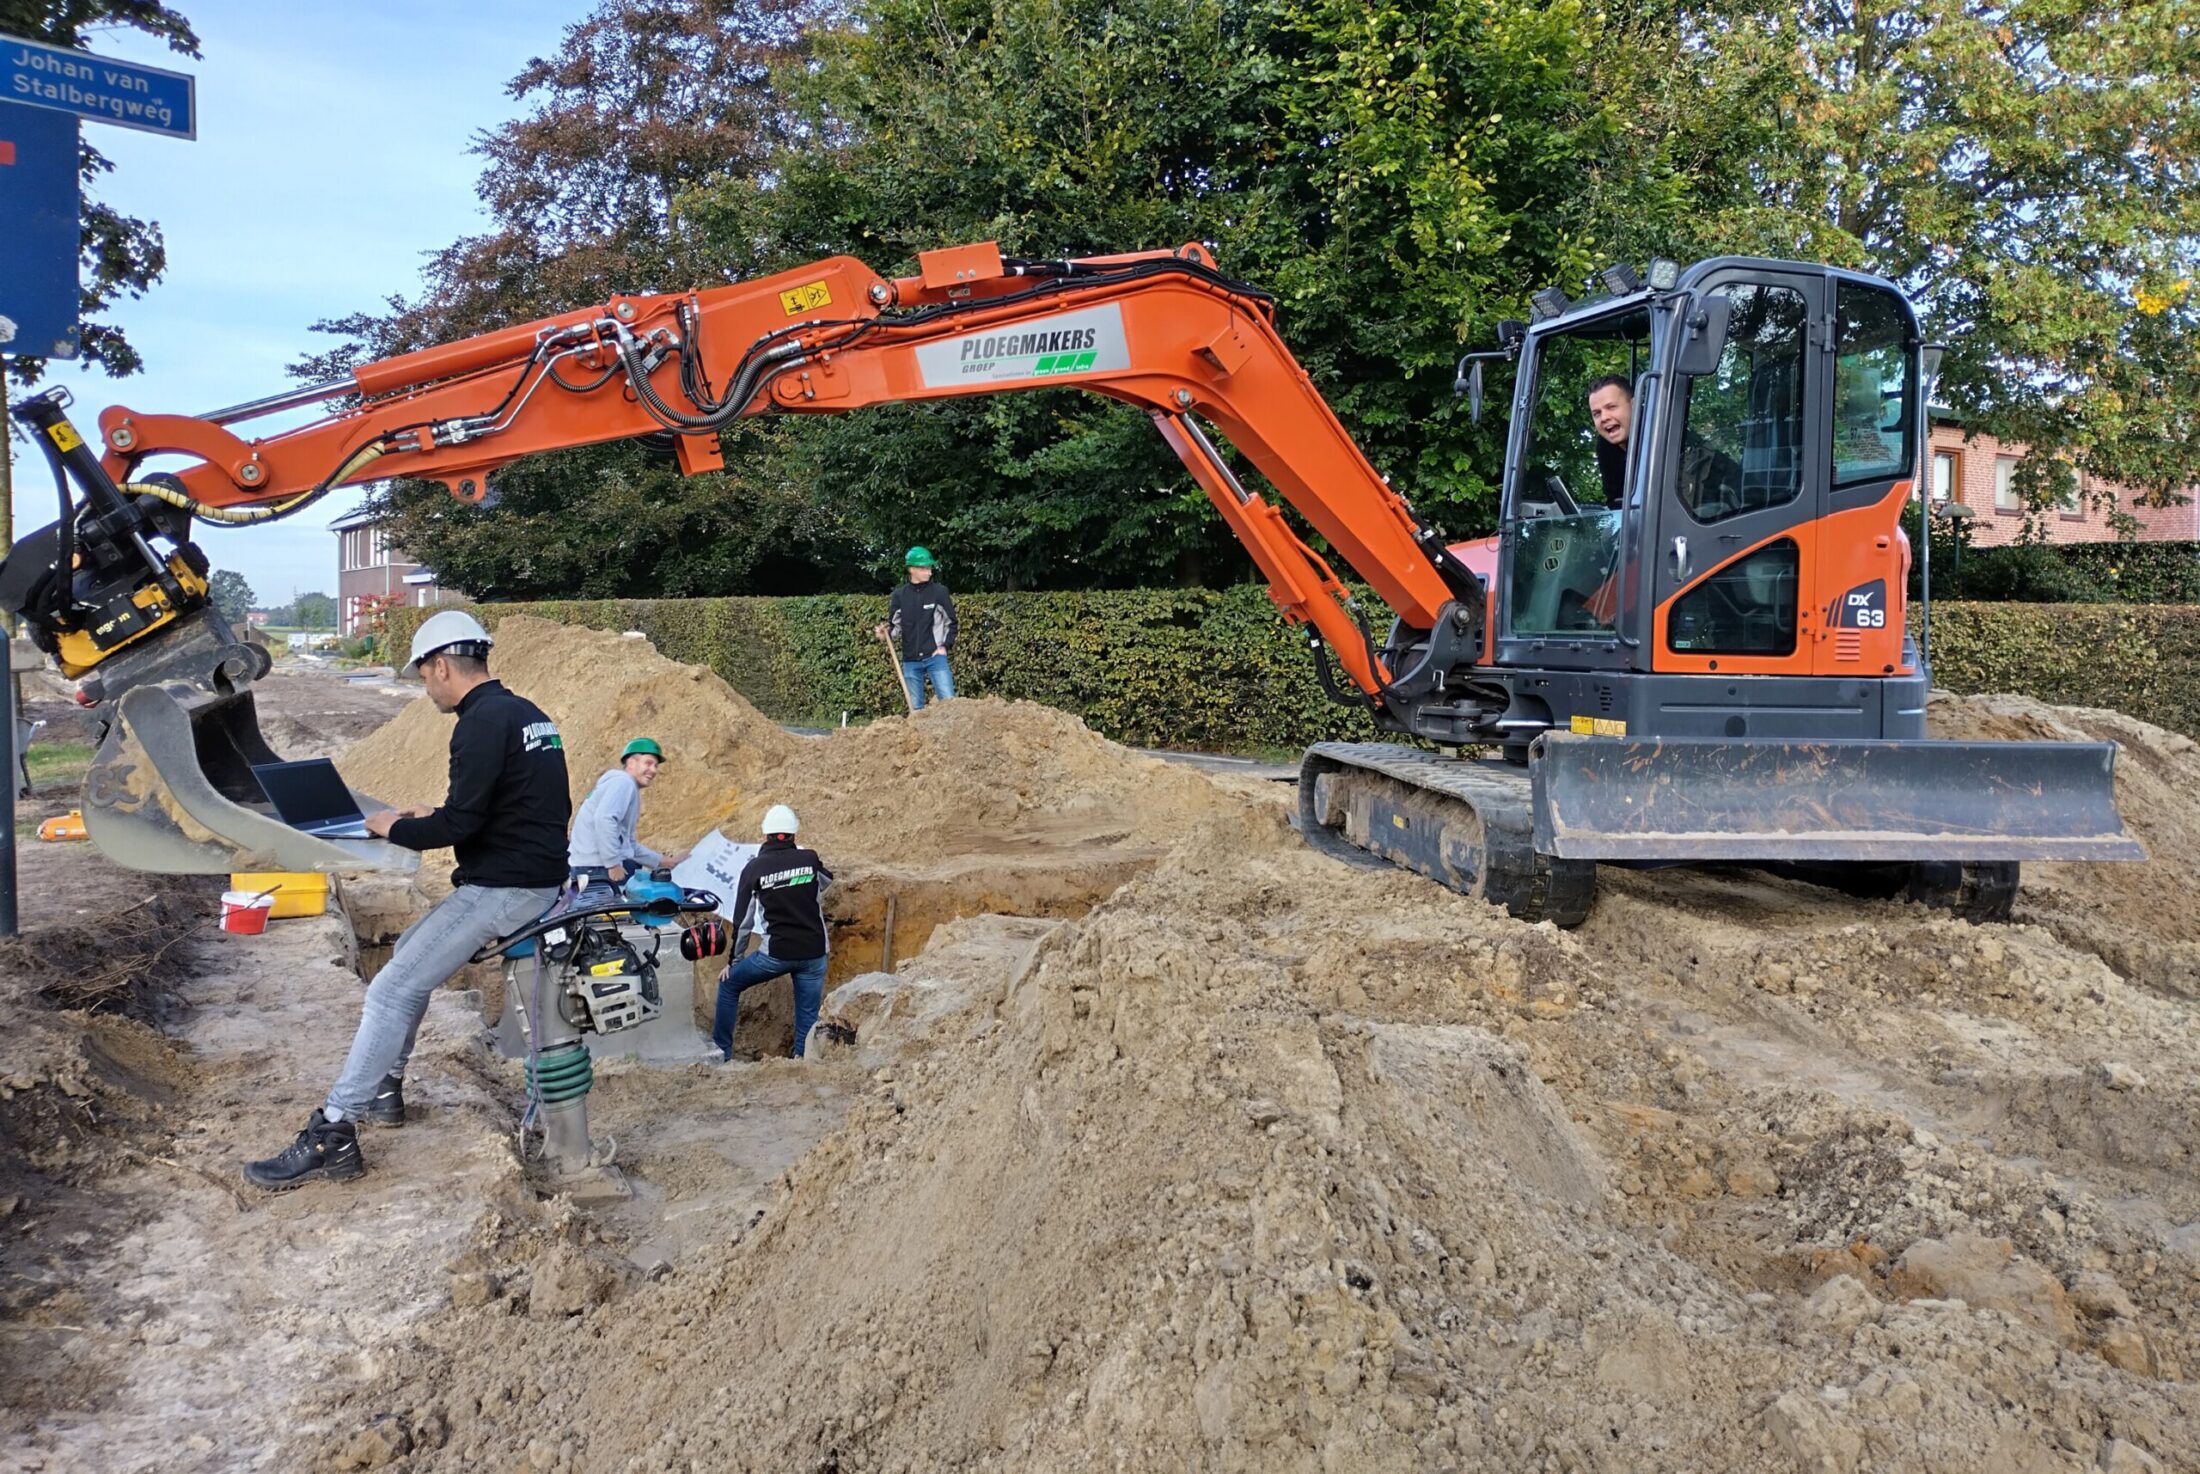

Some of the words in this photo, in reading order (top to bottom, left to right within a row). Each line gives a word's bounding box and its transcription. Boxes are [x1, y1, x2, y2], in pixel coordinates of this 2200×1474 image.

[12, 49, 94, 81] Johan
[104, 70, 149, 93] van
[13, 73, 172, 127] Stalbergweg
[960, 328, 1096, 361] PLOEGMAKERS
[962, 362, 996, 374] GROEP
[1848, 592, 1874, 606] DX
[1857, 609, 1884, 627] 63
[760, 866, 813, 886] PLOEGMAKERS
